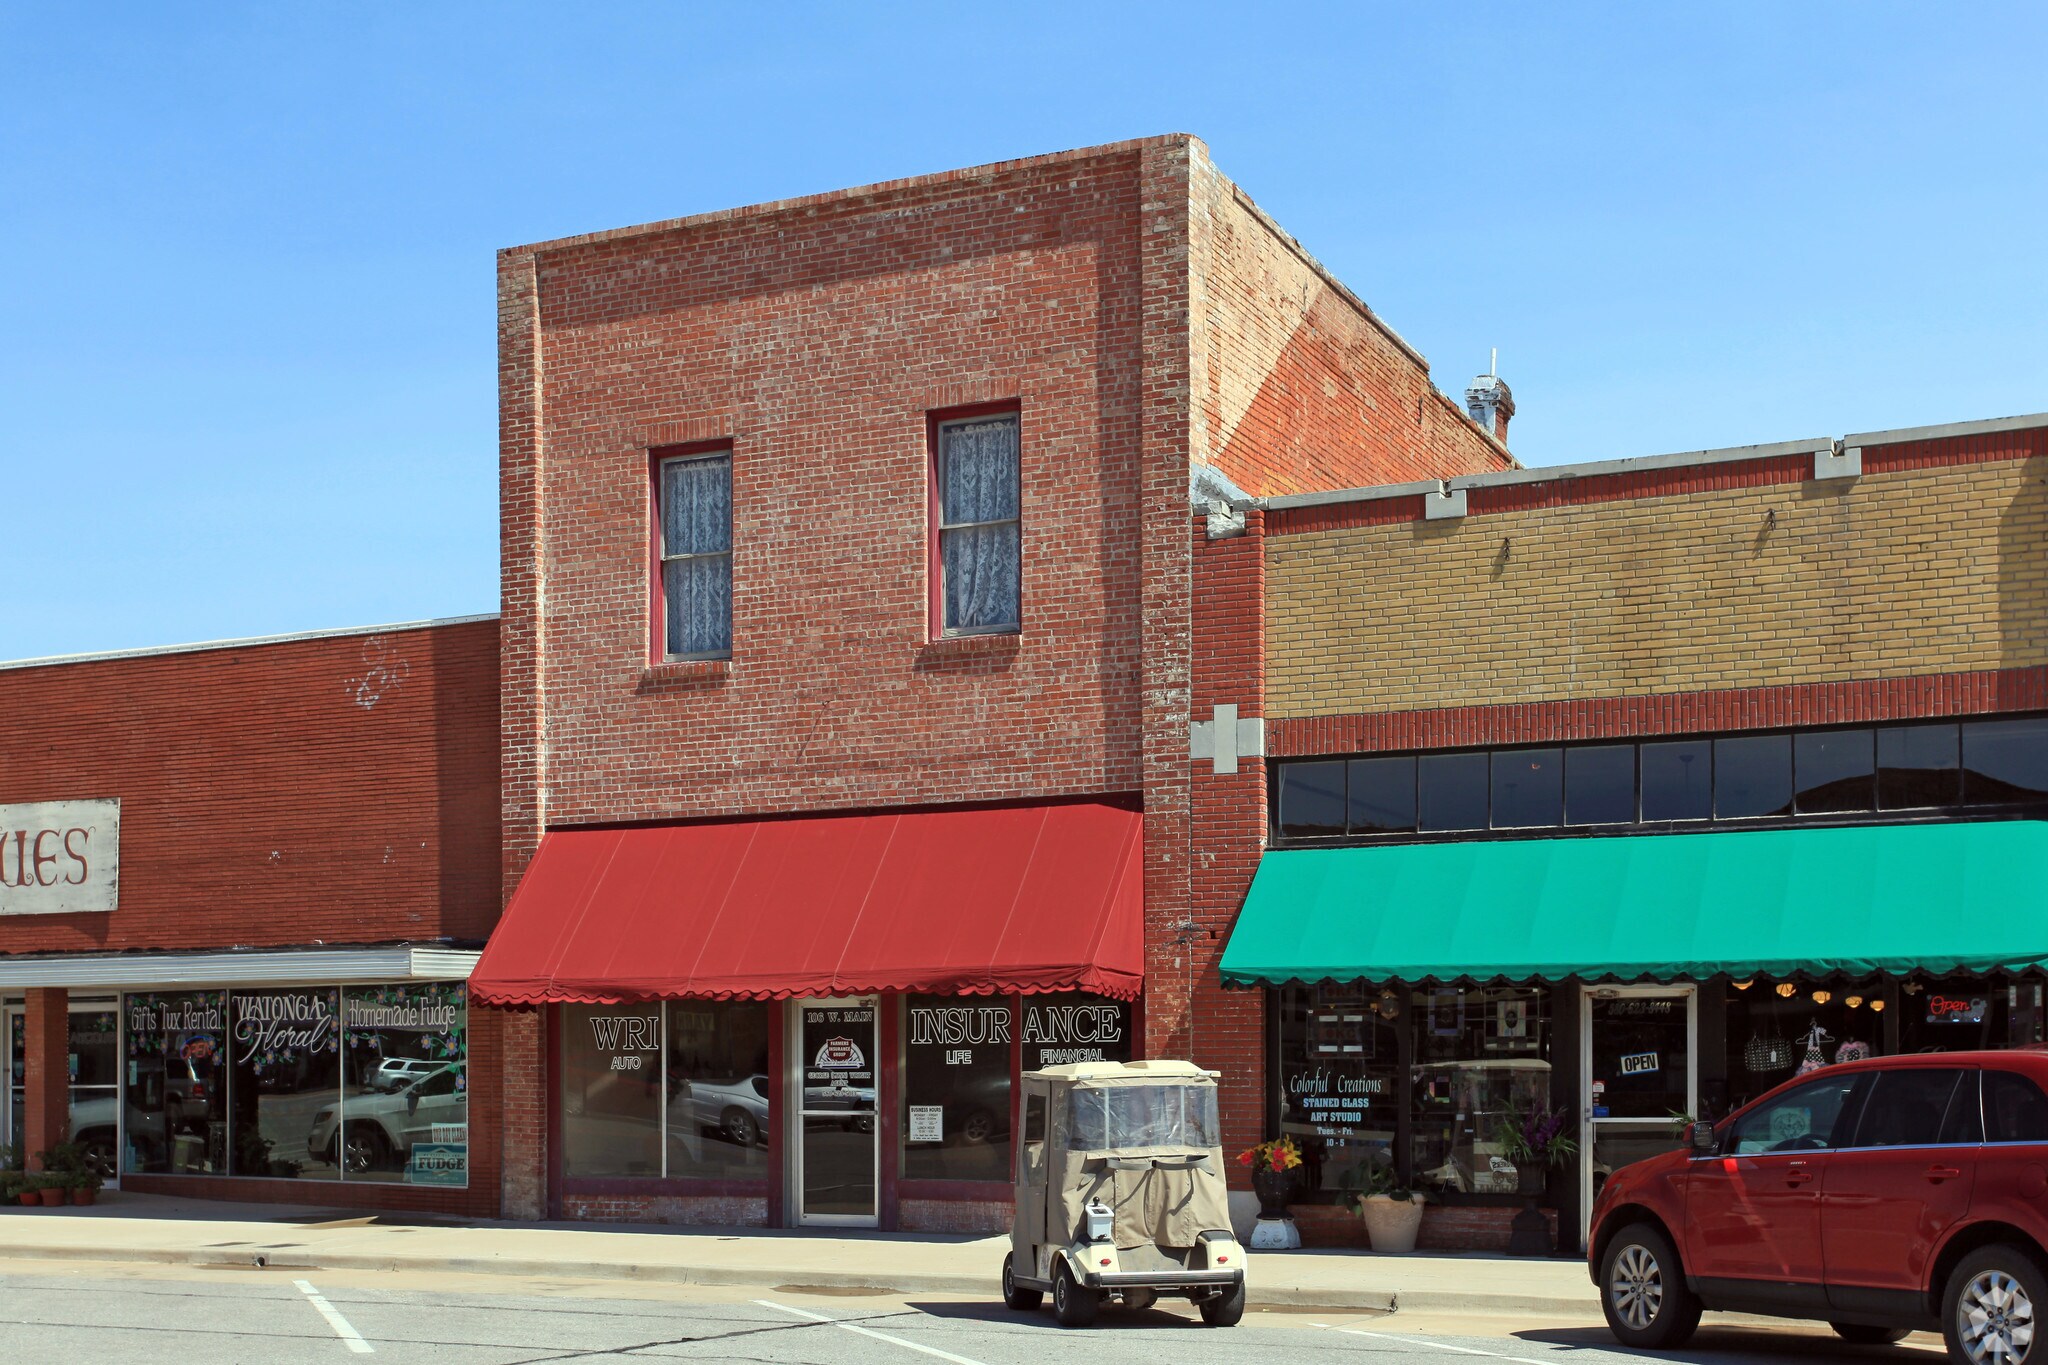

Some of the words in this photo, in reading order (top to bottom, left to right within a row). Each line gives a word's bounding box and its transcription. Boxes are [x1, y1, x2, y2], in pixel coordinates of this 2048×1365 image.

[232, 994, 326, 1021] WATONGA
[131, 1005, 157, 1030] Gifts
[159, 1002, 181, 1030] Tux
[183, 1001, 222, 1030] Rental
[348, 999, 417, 1027] Homemade
[420, 996, 456, 1035] Fudge
[807, 1012, 824, 1023] 106
[827, 1011, 841, 1023] W.
[844, 1011, 873, 1022] MAIN
[235, 1014, 332, 1063] Floral
[590, 1016, 659, 1050] WRI
[611, 1056, 641, 1070] AUTO
[946, 1050, 972, 1065] LIFE
[1040, 1048, 1107, 1063] FINANCIAL
[1624, 1054, 1657, 1072] OPEN
[1290, 1066, 1331, 1097] Colorful
[1337, 1074, 1382, 1093] Creations
[1303, 1098, 1340, 1108] STAINED
[1341, 1098, 1369, 1108] GLASS
[1310, 1112, 1328, 1122] ART
[1330, 1112, 1362, 1122] STUDIO
[1316, 1127, 1337, 1135] Tues.
[1342, 1126, 1354, 1135] Fri.
[1326, 1139, 1334, 1147] 10
[1340, 1139, 1345, 1147] 5
[418, 1157, 465, 1170] FUDGE
